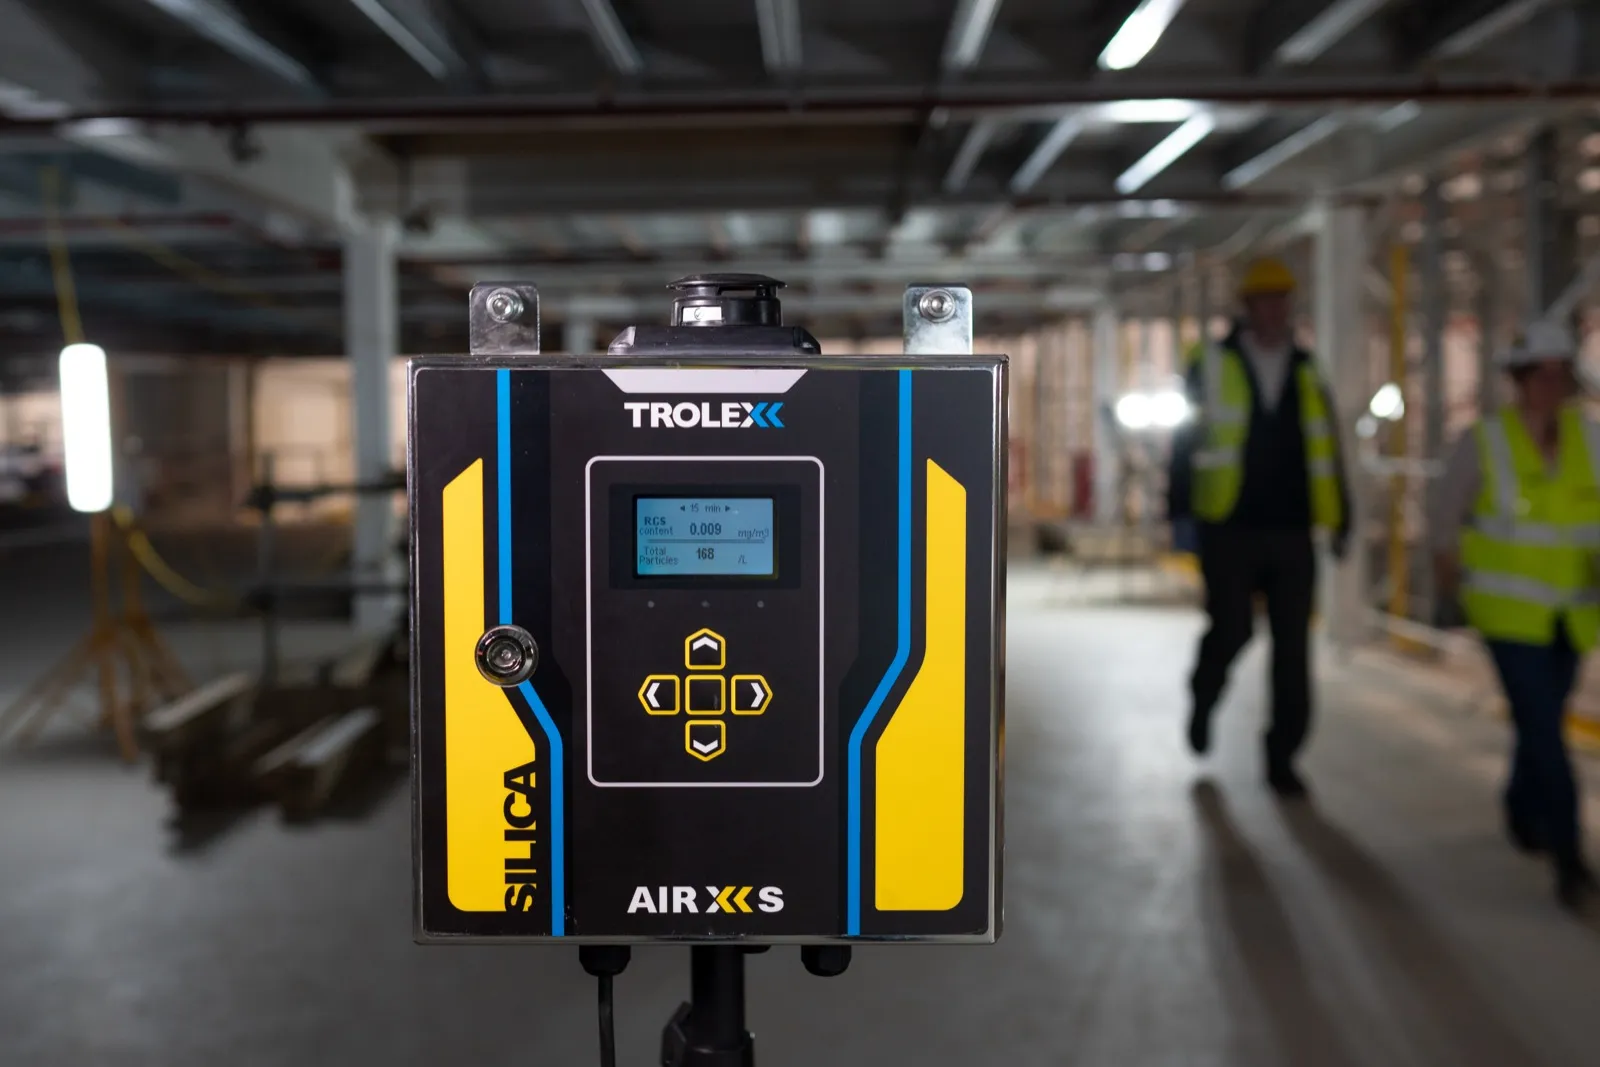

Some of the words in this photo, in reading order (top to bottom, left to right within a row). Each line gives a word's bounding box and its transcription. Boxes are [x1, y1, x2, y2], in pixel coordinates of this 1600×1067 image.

[624, 402, 769, 428] TROLEX
[689, 503, 699, 513] 15
[705, 503, 721, 512] min
[644, 516, 666, 526] RCS
[639, 526, 674, 535] content
[689, 522, 722, 536] 0.009
[644, 547, 667, 556] Total
[696, 547, 715, 560] 168
[639, 555, 679, 565] Particles
[503, 760, 537, 912] SILICA
[627, 886, 699, 913] AIR
